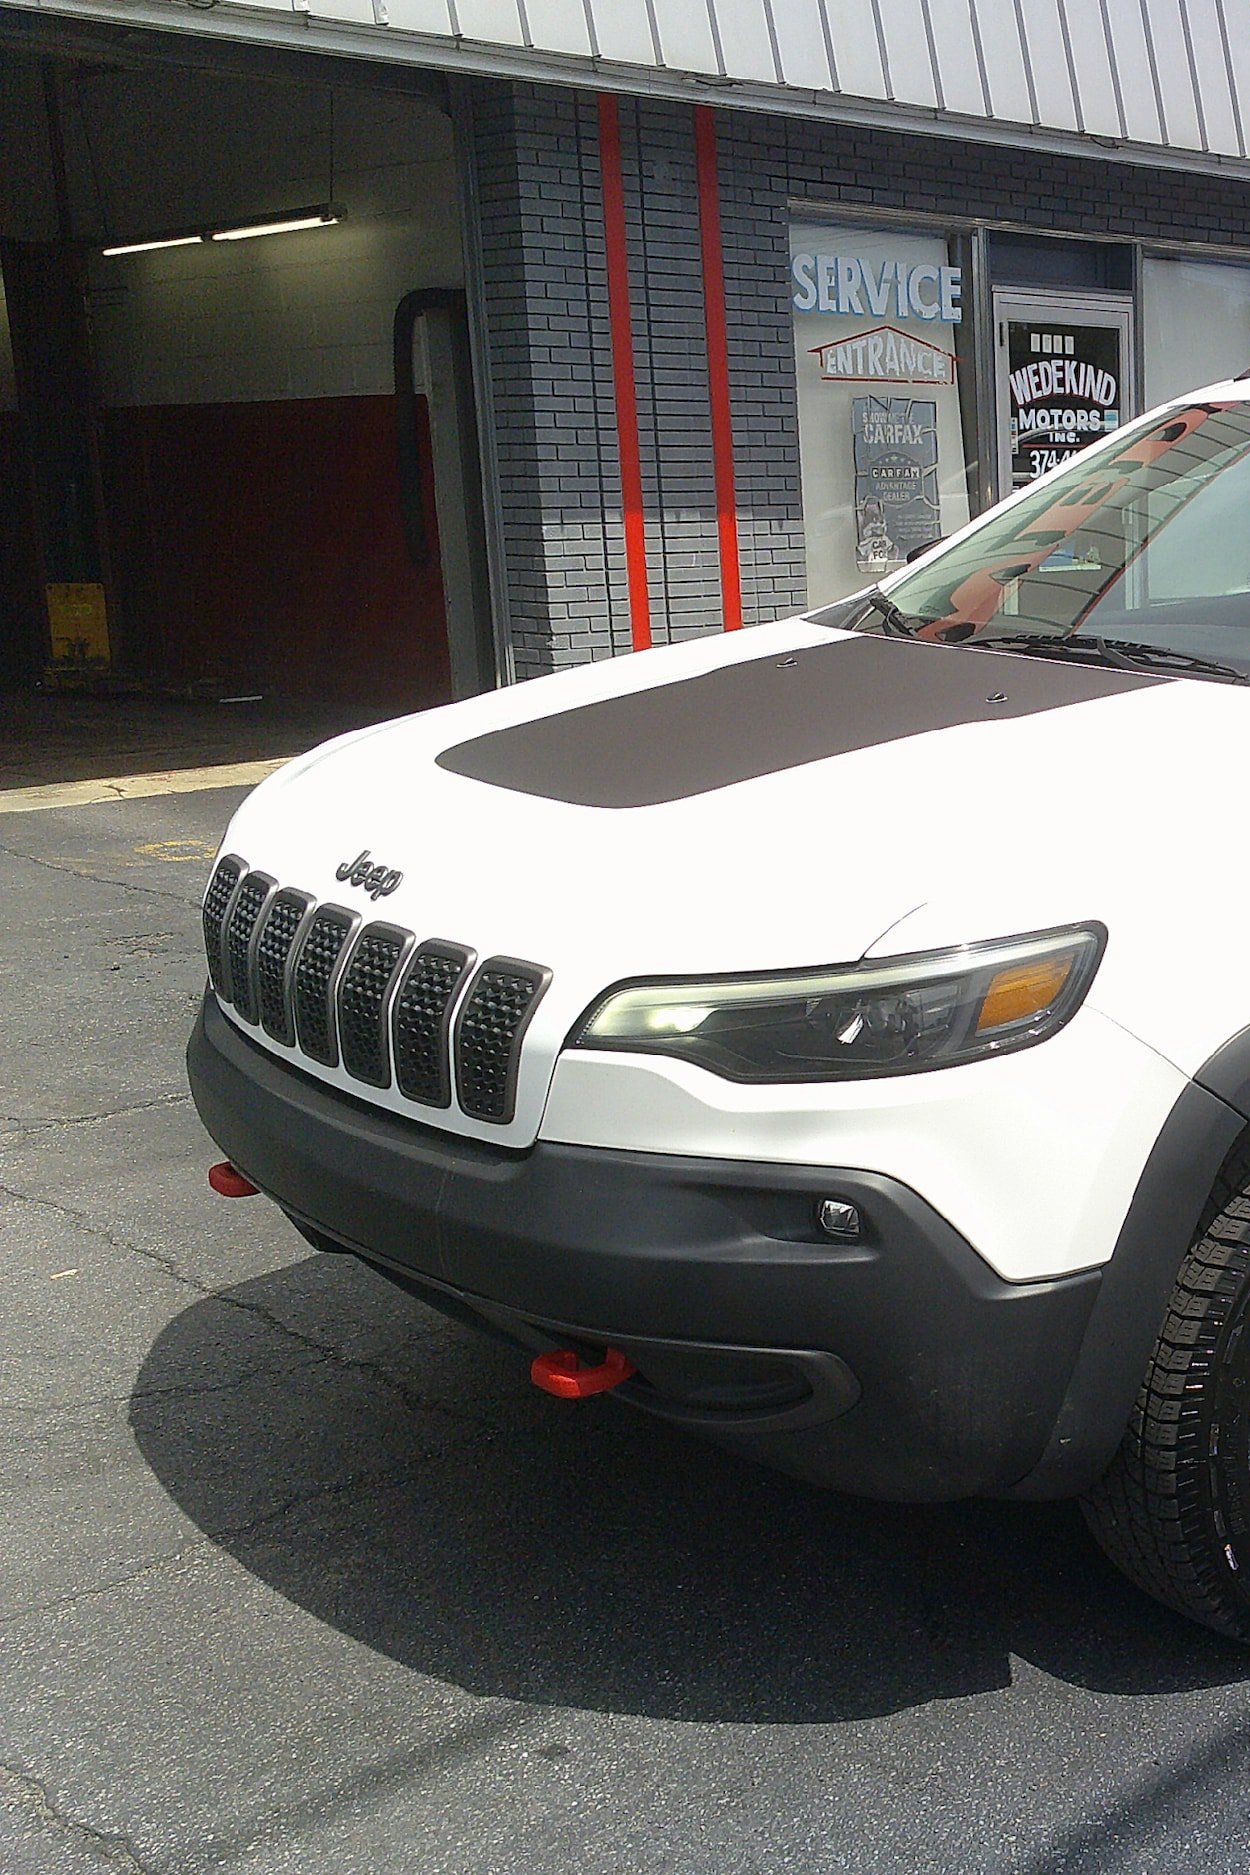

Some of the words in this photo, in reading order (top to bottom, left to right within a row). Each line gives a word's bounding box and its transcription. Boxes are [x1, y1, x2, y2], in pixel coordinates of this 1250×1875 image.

[793, 253, 962, 322] SERVICE
[826, 331, 945, 377] ENTRANCE
[1009, 359, 1117, 406] WEDEKIND
[863, 423, 923, 444] CARFAX
[1019, 408, 1101, 431] MOTORS
[871, 467, 920, 479] CARFAX
[336, 849, 404, 901] Jeep
